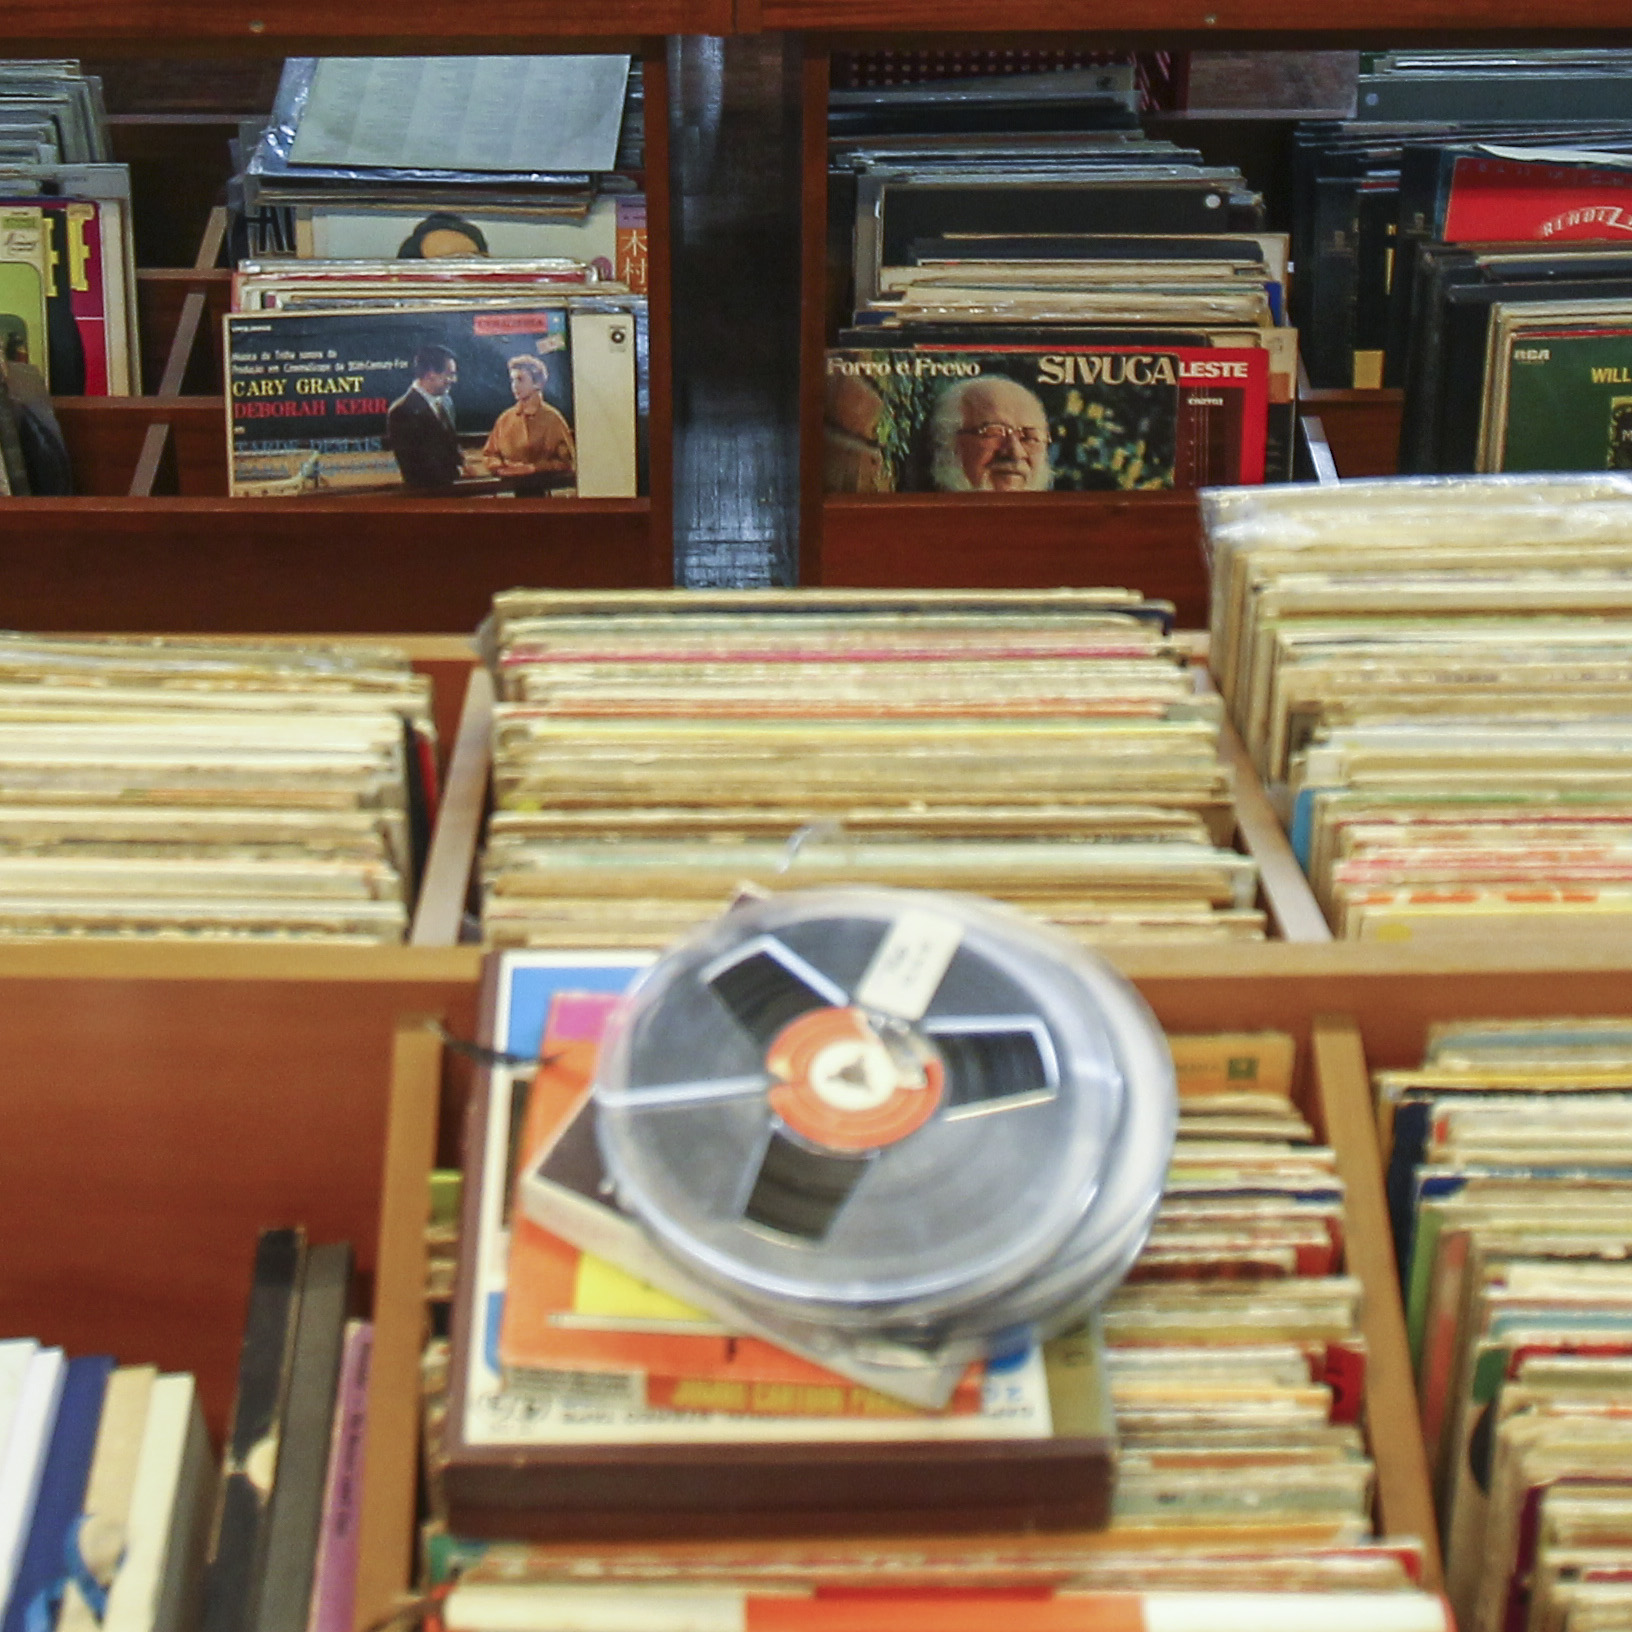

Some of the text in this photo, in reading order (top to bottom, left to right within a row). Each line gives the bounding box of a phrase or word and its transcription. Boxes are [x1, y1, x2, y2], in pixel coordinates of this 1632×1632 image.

[1514, 350, 1550, 361] RCA
[896, 357, 981, 377] e Frevo
[1037, 355, 1178, 385] SIVUCA
[1591, 367, 1632, 383] WILL
[232, 376, 364, 397] CARY GRANT
[234, 398, 388, 418] DEBORAH KERR
